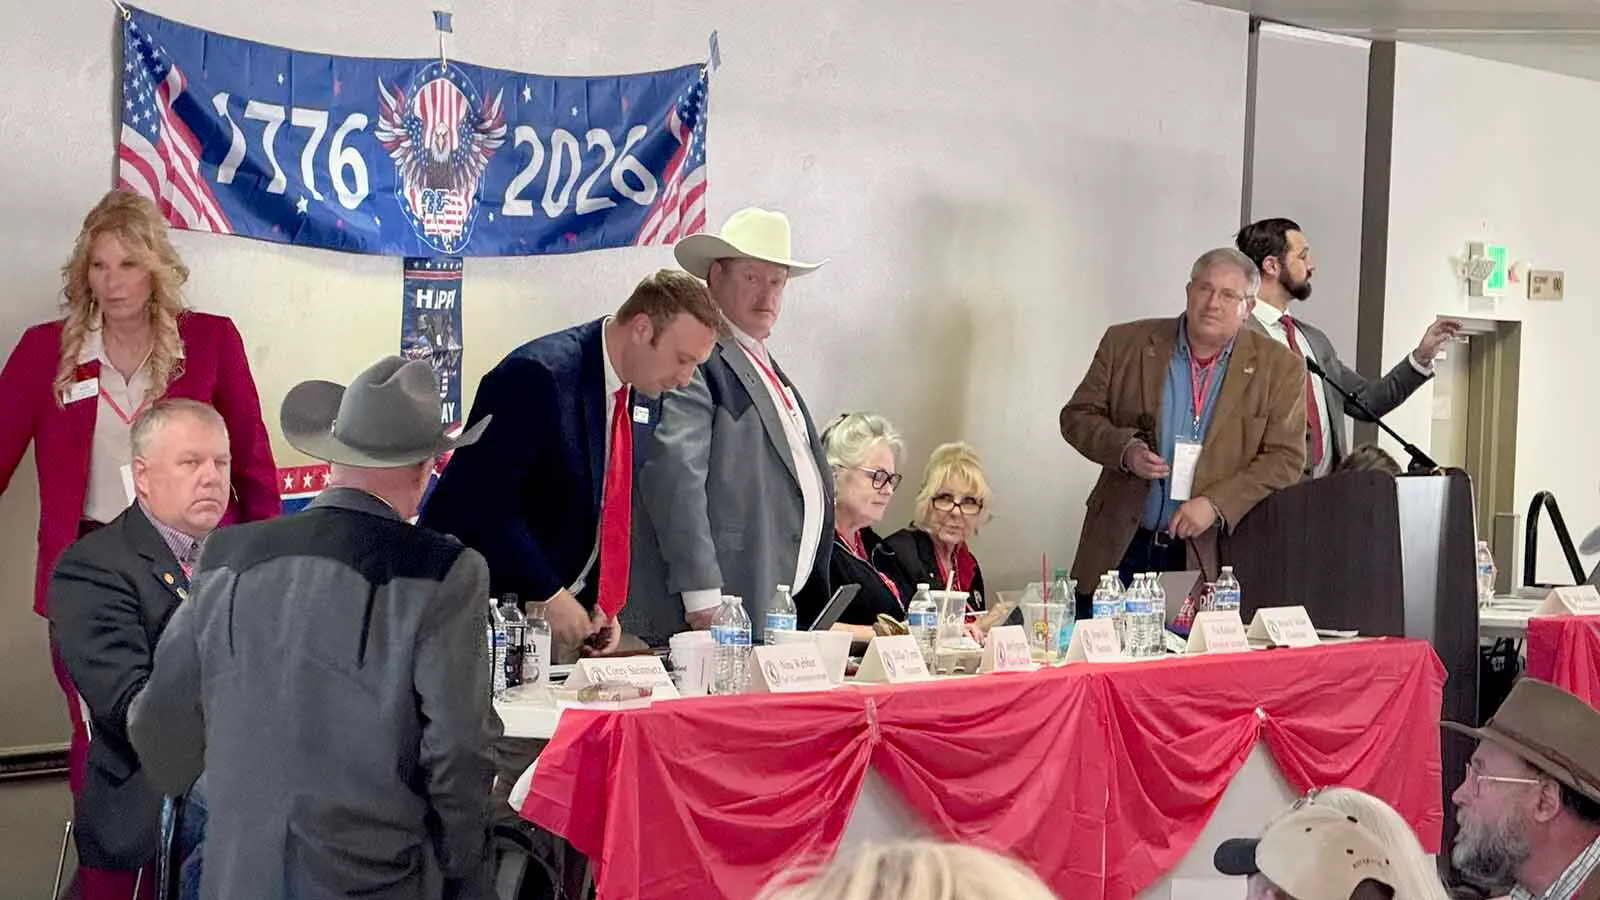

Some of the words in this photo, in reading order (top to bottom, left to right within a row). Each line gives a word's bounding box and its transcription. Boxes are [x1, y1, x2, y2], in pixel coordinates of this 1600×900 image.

[213, 91, 370, 210] 1776
[501, 123, 658, 217] 2026
[440, 402, 456, 424] AY
